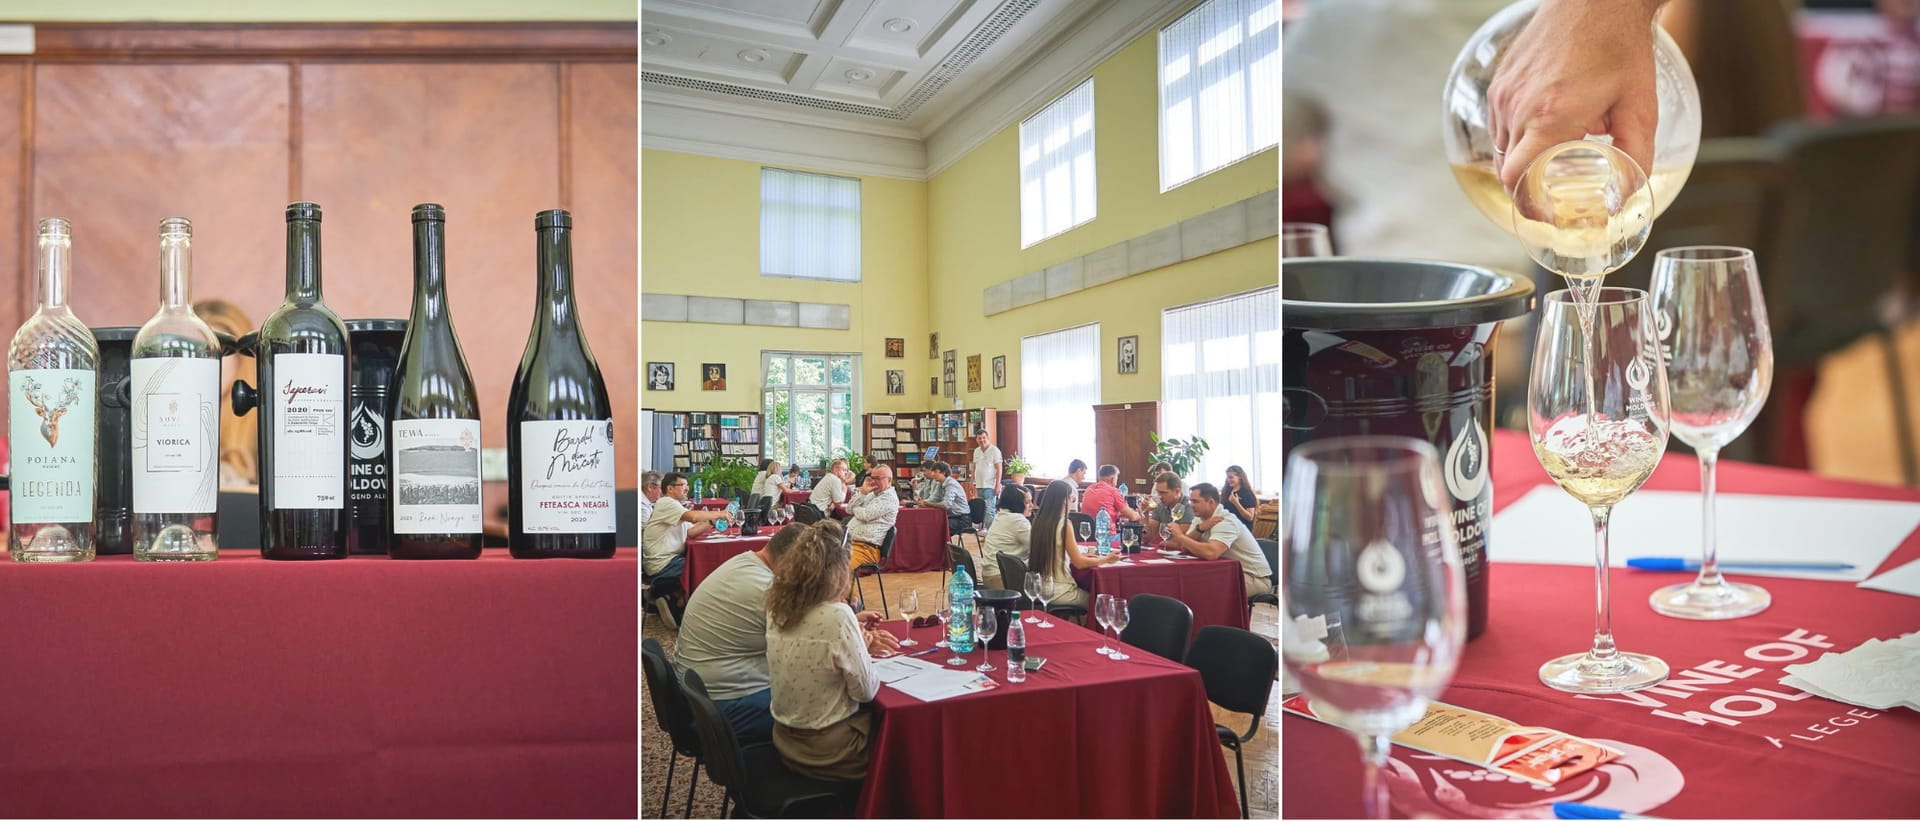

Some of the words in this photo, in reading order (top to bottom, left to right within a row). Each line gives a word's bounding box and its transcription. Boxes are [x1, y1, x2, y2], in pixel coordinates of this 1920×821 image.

[398, 428, 424, 438] TEWA
[156, 438, 191, 446] VIORICA
[27, 456, 76, 464] POIANA
[350, 463, 373, 476] INE
[374, 463, 386, 476] O
[22, 480, 82, 498] LEGENDA
[350, 478, 386, 490] LDO
[1743, 628, 1835, 662] OF
[1651, 686, 1817, 727] MOL
[1790, 707, 1888, 742] LEGE
